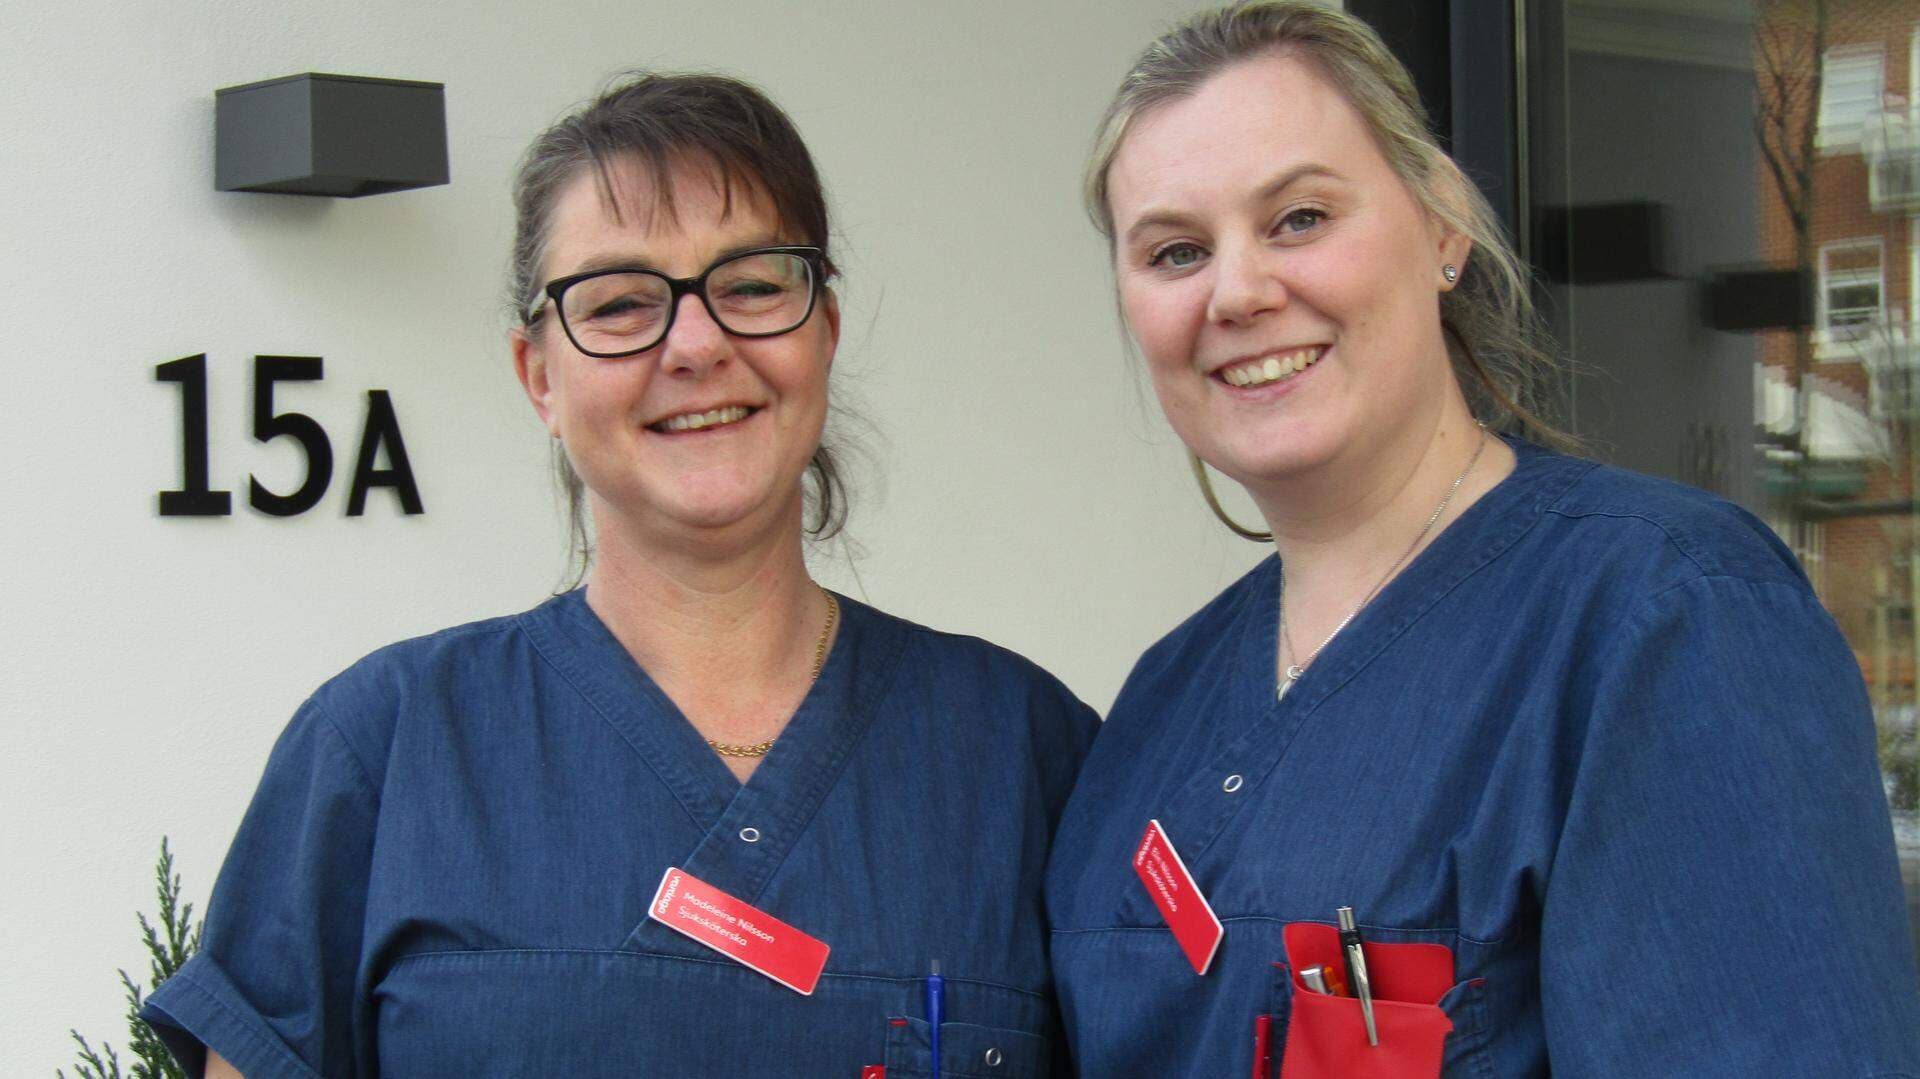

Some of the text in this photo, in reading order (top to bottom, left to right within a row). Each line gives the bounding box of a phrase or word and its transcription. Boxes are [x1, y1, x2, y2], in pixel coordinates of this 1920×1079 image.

[156, 353, 424, 517] 15A
[683, 892, 775, 944] Madeleine Nilsson
